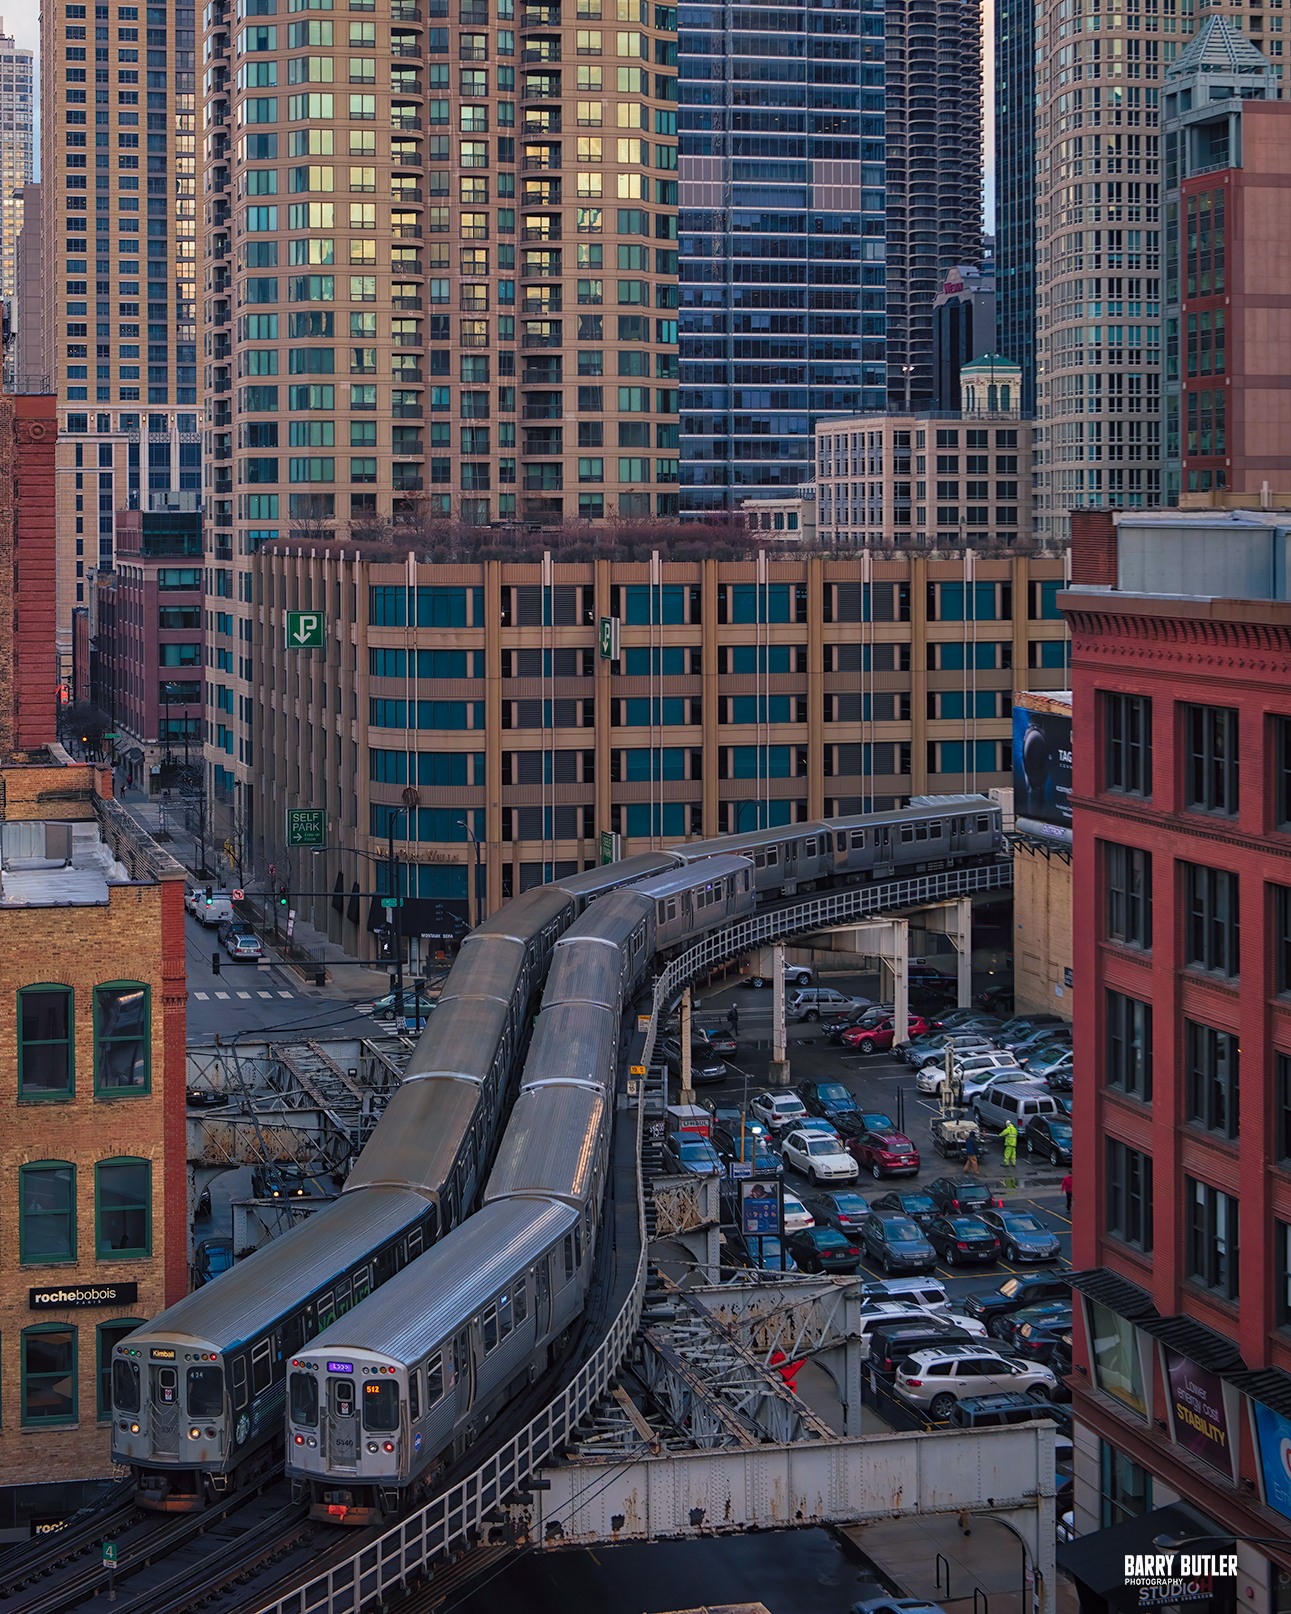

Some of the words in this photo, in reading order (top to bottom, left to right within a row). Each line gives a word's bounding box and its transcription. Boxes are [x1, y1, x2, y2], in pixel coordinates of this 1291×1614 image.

[292, 813, 319, 822] SELF
[292, 822, 320, 831] PARK
[35, 1287, 117, 1303] rochebobois
[152, 1350, 175, 1358] Kimball
[366, 1385, 380, 1393] 512
[1176, 1403, 1225, 1447] STABILITY
[105, 1545, 114, 1558] 4
[1138, 1581, 1200, 1600] STUDIO
